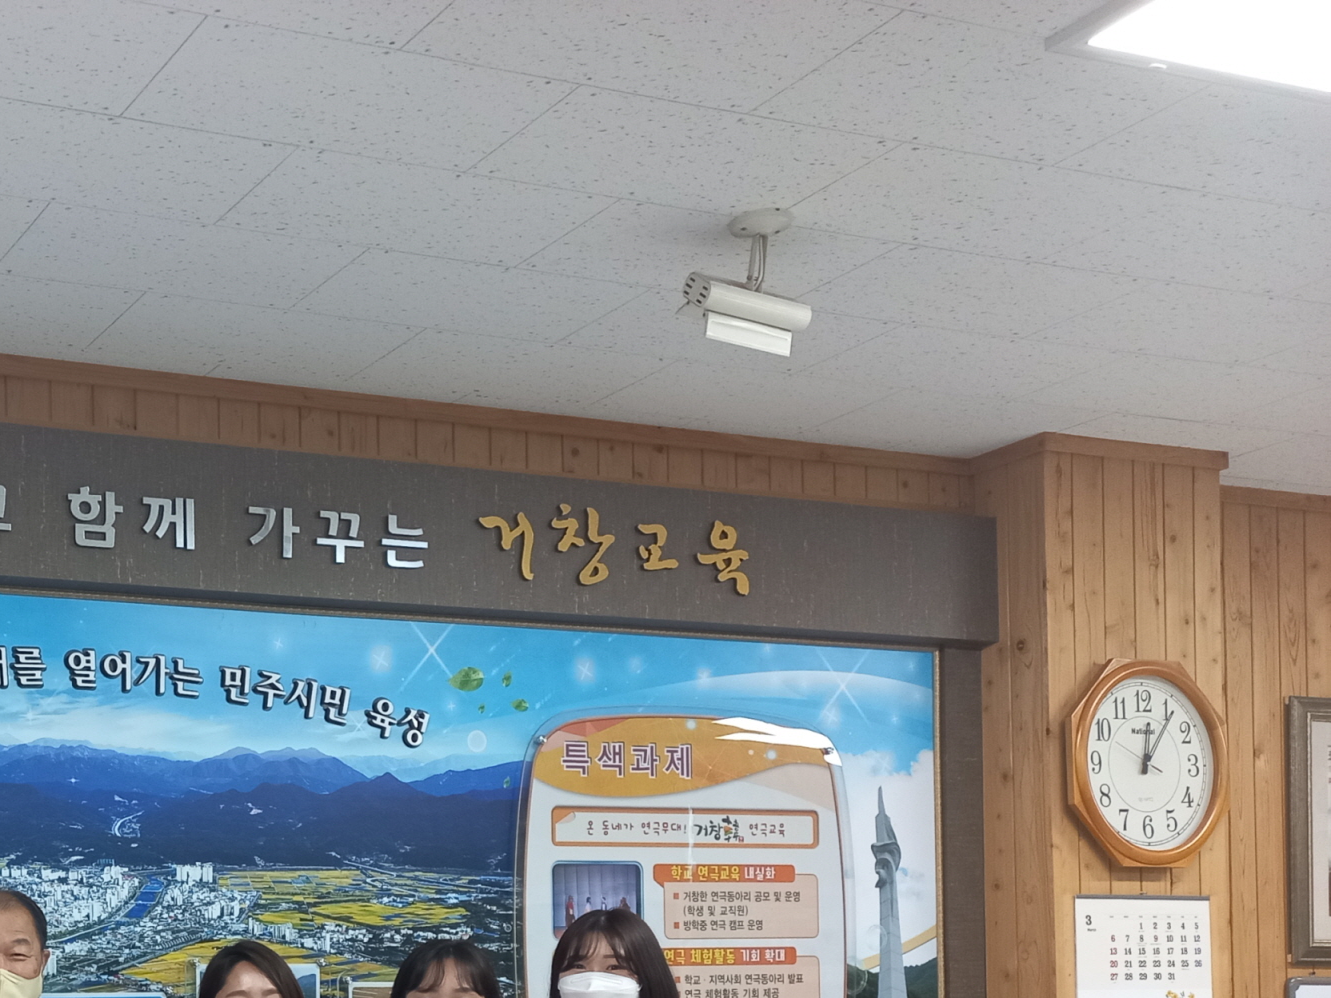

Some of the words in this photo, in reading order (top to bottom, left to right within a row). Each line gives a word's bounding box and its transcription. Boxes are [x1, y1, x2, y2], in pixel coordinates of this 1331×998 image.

[67, 485, 196, 551] 함께
[247, 505, 429, 569] 가꾸는
[478, 503, 750, 596] 거창교육
[64, 648, 204, 698] 열어가는
[219, 665, 352, 726] 민주시민
[365, 697, 431, 749] 육성
[1112, 696, 1128, 720] 11
[1134, 689, 1152, 713] 12
[1095, 717, 1112, 742] 10
[1179, 721, 1192, 744] 2
[561, 741, 692, 779] 특색과제
[1090, 750, 1102, 774] 9
[1187, 754, 1200, 777] 3
[1099, 783, 1112, 808] 8
[1181, 786, 1194, 808] 4
[586, 820, 595, 835] 온
[601, 820, 634, 835] 동네가
[748, 822, 786, 837] 연극교육
[1119, 808, 1130, 831] 7
[1142, 815, 1155, 839] 6
[1166, 809, 1178, 832] 5
[671, 865, 693, 880] 학교
[697, 865, 741, 881] 연극교육
[744, 865, 776, 880] 내실화
[683, 891, 708, 903] 거창한
[710, 891, 751, 903] 연극동아리
[754, 891, 770, 902] 공모
[773, 890, 782, 903] 및
[784, 890, 800, 903] 운영
[707, 905, 716, 917] 및
[1085, 915, 1092, 926] 3
[683, 920, 707, 932] 방학중
[710, 919, 726, 932] 연극
[729, 919, 745, 931] 캠프
[747, 919, 764, 931] 운영
[663, 949, 686, 964] 연극
[690, 948, 736, 964] 체험활동
[740, 949, 760, 962] 기회
[764, 948, 786, 962] 확대
[742, 988, 759, 998] 기회
